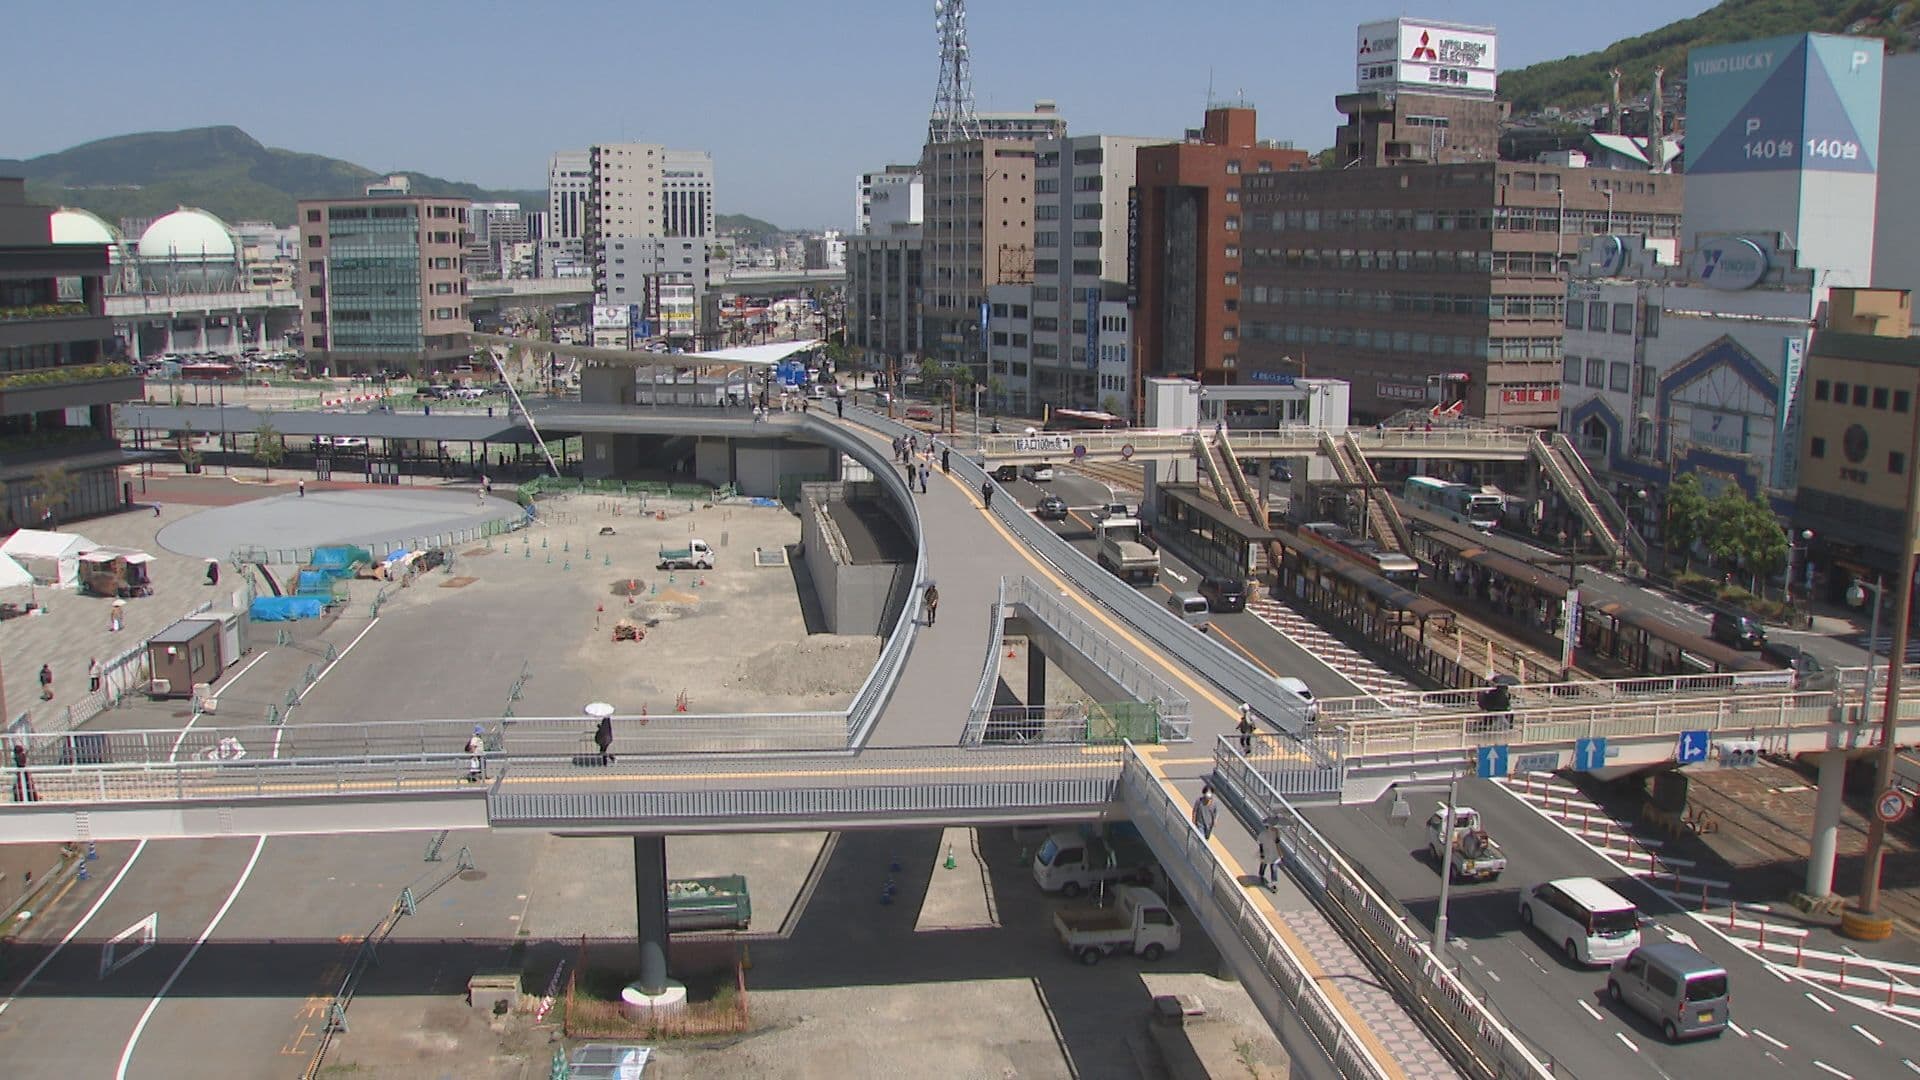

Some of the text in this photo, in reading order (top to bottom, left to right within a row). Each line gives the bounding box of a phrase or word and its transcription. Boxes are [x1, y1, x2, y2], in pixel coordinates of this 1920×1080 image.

[1440, 40, 1487, 56] MITSUBISHI
[1439, 51, 1481, 66] ELECTRIC
[1729, 52, 1774, 73] LUCKY
[1852, 51, 1868, 70] P
[1746, 119, 1760, 136] P
[1743, 139, 1794, 160] 140台
[1807, 139, 1858, 160] 140台
